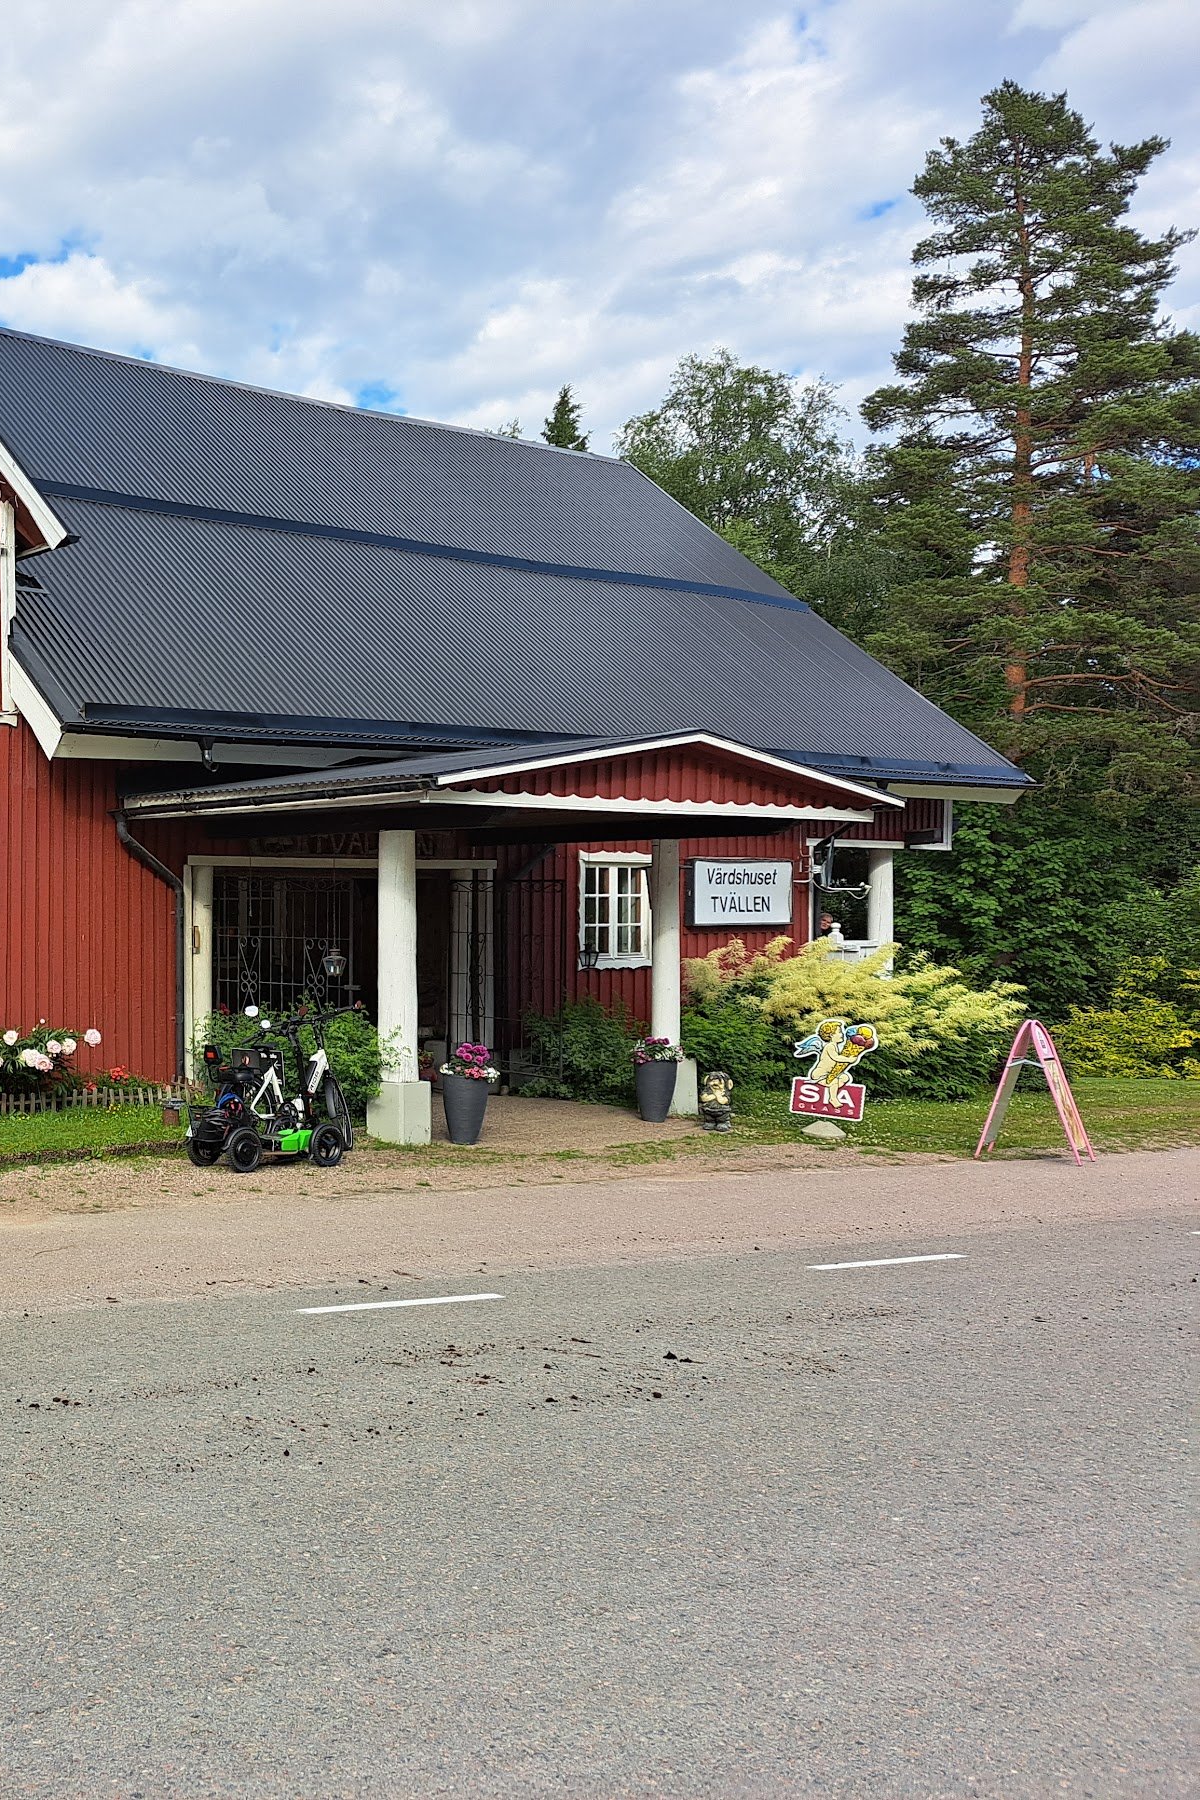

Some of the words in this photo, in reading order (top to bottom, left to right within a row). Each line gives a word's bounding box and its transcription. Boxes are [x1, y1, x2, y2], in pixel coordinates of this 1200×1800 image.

[707, 867, 777, 885] Värdshuset
[710, 891, 771, 912] TVÄLLEN
[798, 1084, 855, 1108] SIA
[798, 1102, 854, 1115] GLASS
